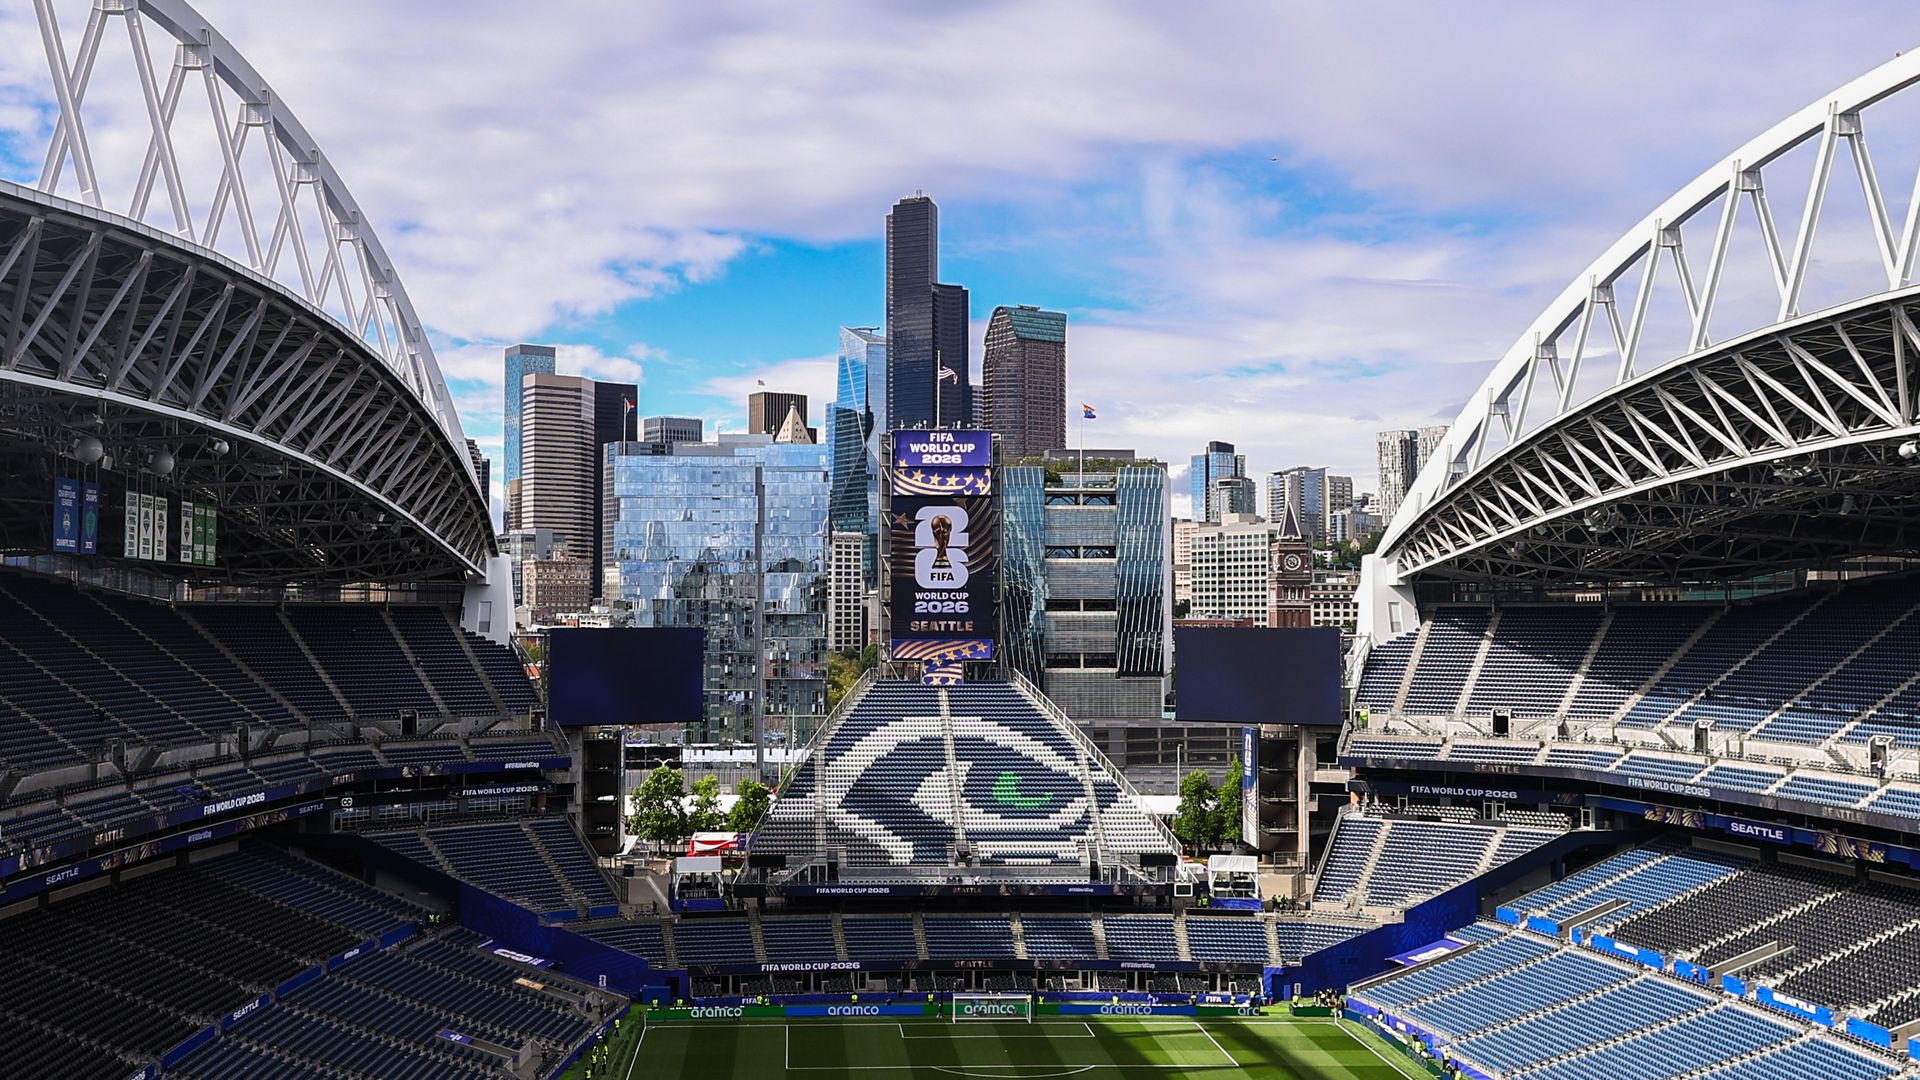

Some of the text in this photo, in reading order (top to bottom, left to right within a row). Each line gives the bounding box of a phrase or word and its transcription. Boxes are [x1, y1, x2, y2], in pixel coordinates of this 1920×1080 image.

[930, 433, 954, 442] FIFA
[910, 443, 976, 453] WORLD CUP
[922, 454, 962, 464] 2026
[930, 573, 954, 581] FIFA
[915, 592, 969, 600] WORLD CUP
[914, 602, 969, 613] 2026
[910, 621, 973, 631] SEATTLE
[1474, 764, 1520, 773] SEATTLE
[332, 773, 354, 785] SEATTLE
[1410, 785, 1518, 799] FIFA WORLD CUP 2026
[1628, 777, 1711, 797] FIFA WORLD CUP 2026
[203, 792, 266, 816] FIFA WORLD CUP 2026
[299, 803, 324, 814] SEATTLE
[1822, 806, 1863, 821] SEATTLE
[95, 827, 124, 845] SEATTLE
[1731, 822, 1784, 840] SEATTLE
[46, 867, 79, 885] SEATTLE
[761, 962, 861, 972] FIFA WORLD CUP 2026
[1772, 992, 1817, 1014] SEATTLE
[232, 999, 259, 1020] SEATTLE
[691, 1006, 742, 1018] aramco
[828, 1005, 879, 1016] aramco
[964, 1004, 1015, 1015] aramco
[1100, 1004, 1152, 1015] aramco
